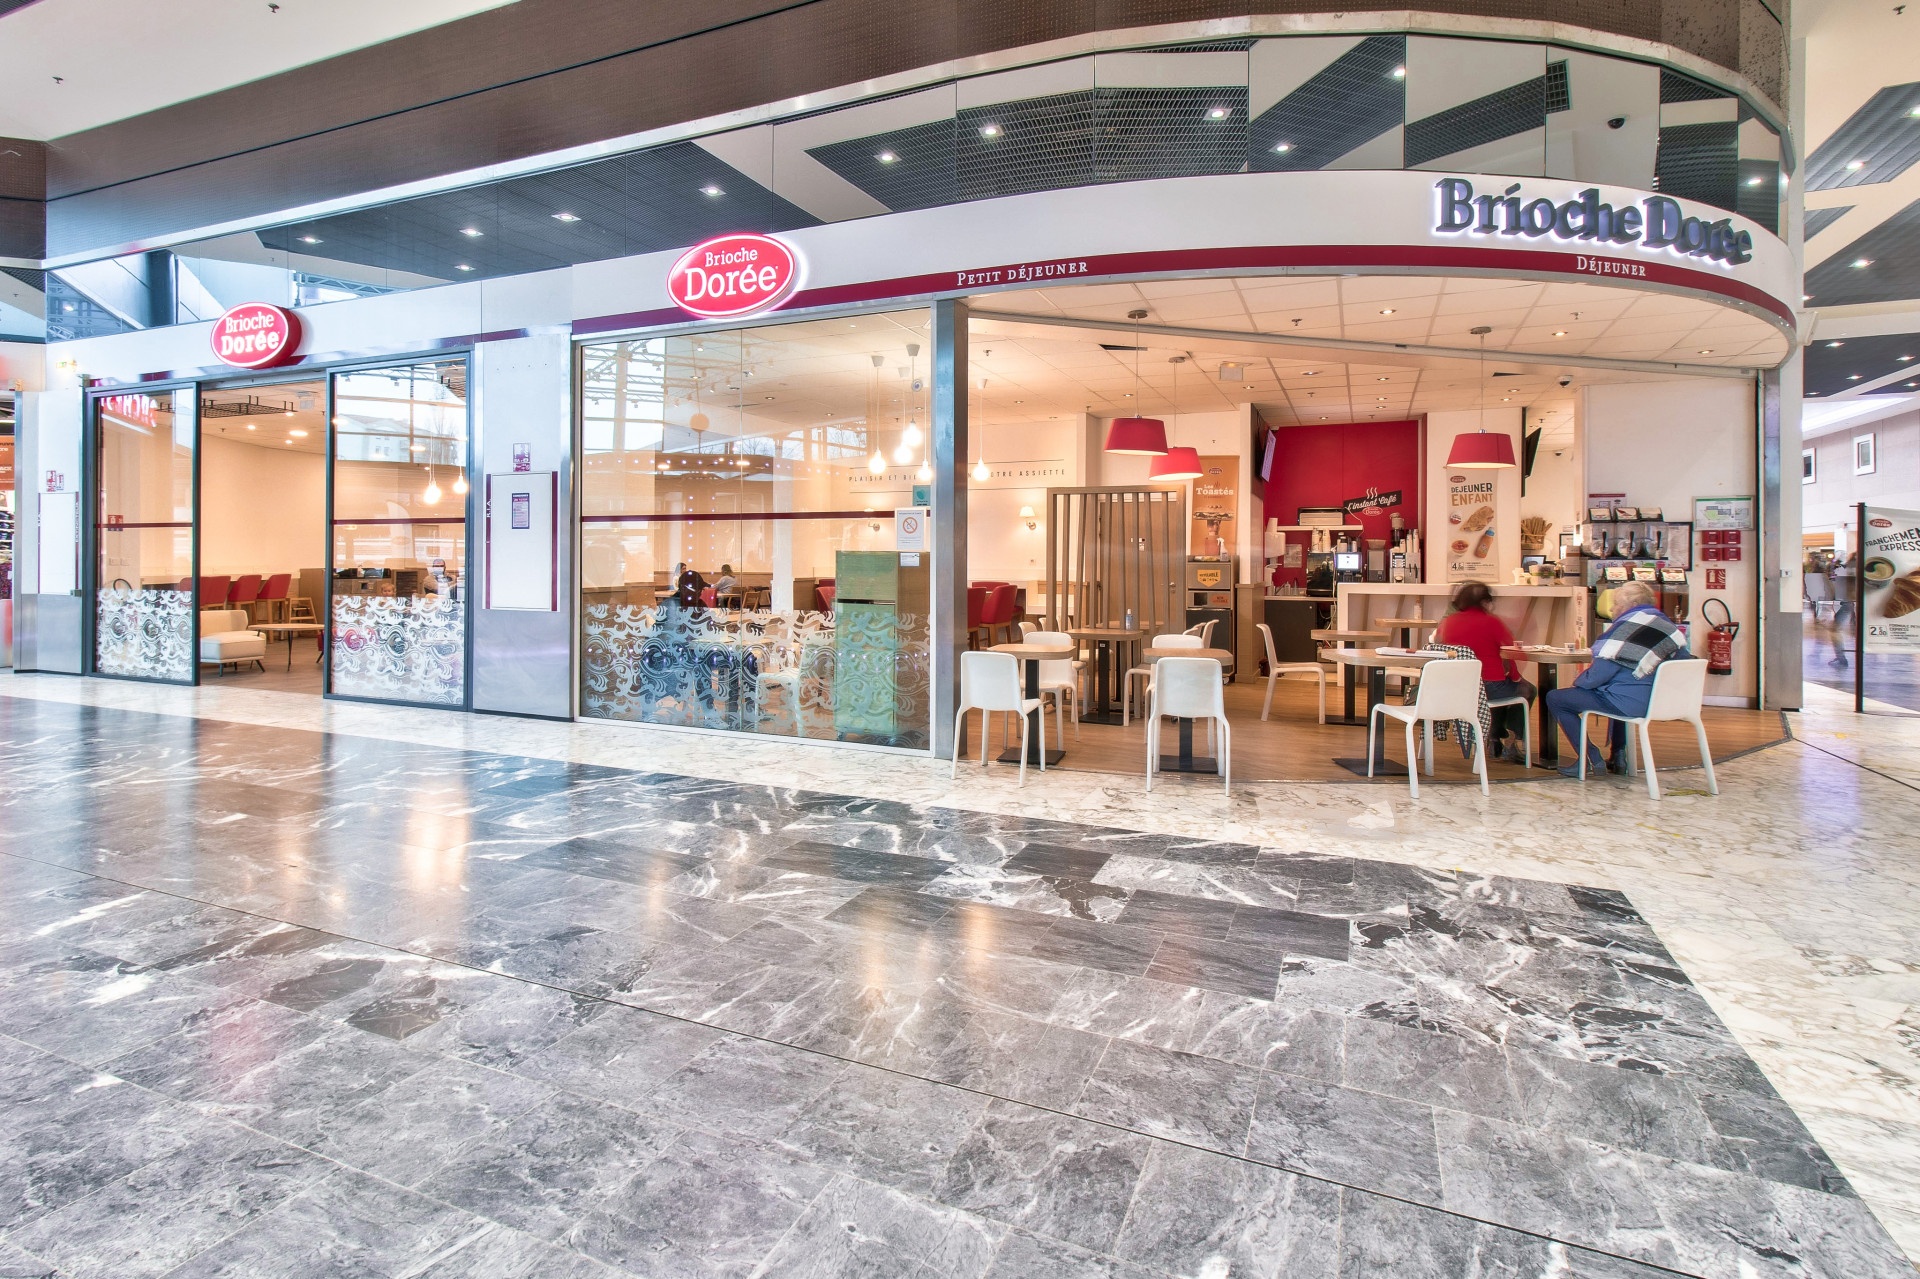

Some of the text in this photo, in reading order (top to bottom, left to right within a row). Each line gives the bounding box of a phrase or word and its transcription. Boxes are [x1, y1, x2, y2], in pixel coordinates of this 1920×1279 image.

[1435, 177, 1753, 266] Brioche Dorée
[705, 247, 758, 267] Brioche
[1576, 256, 1646, 276] DÉJEUNER
[684, 264, 777, 301] Dorée
[957, 262, 1088, 286] PETIT DÉJEUNER
[225, 311, 275, 334] Brioche
[221, 330, 279, 356] Dorée
[1019, 468, 1065, 477] ASSIETTE
[1195, 486, 1234, 495] Toastés
[1378, 494, 1397, 506] Café
[1451, 493, 1493, 506] ENFANT
